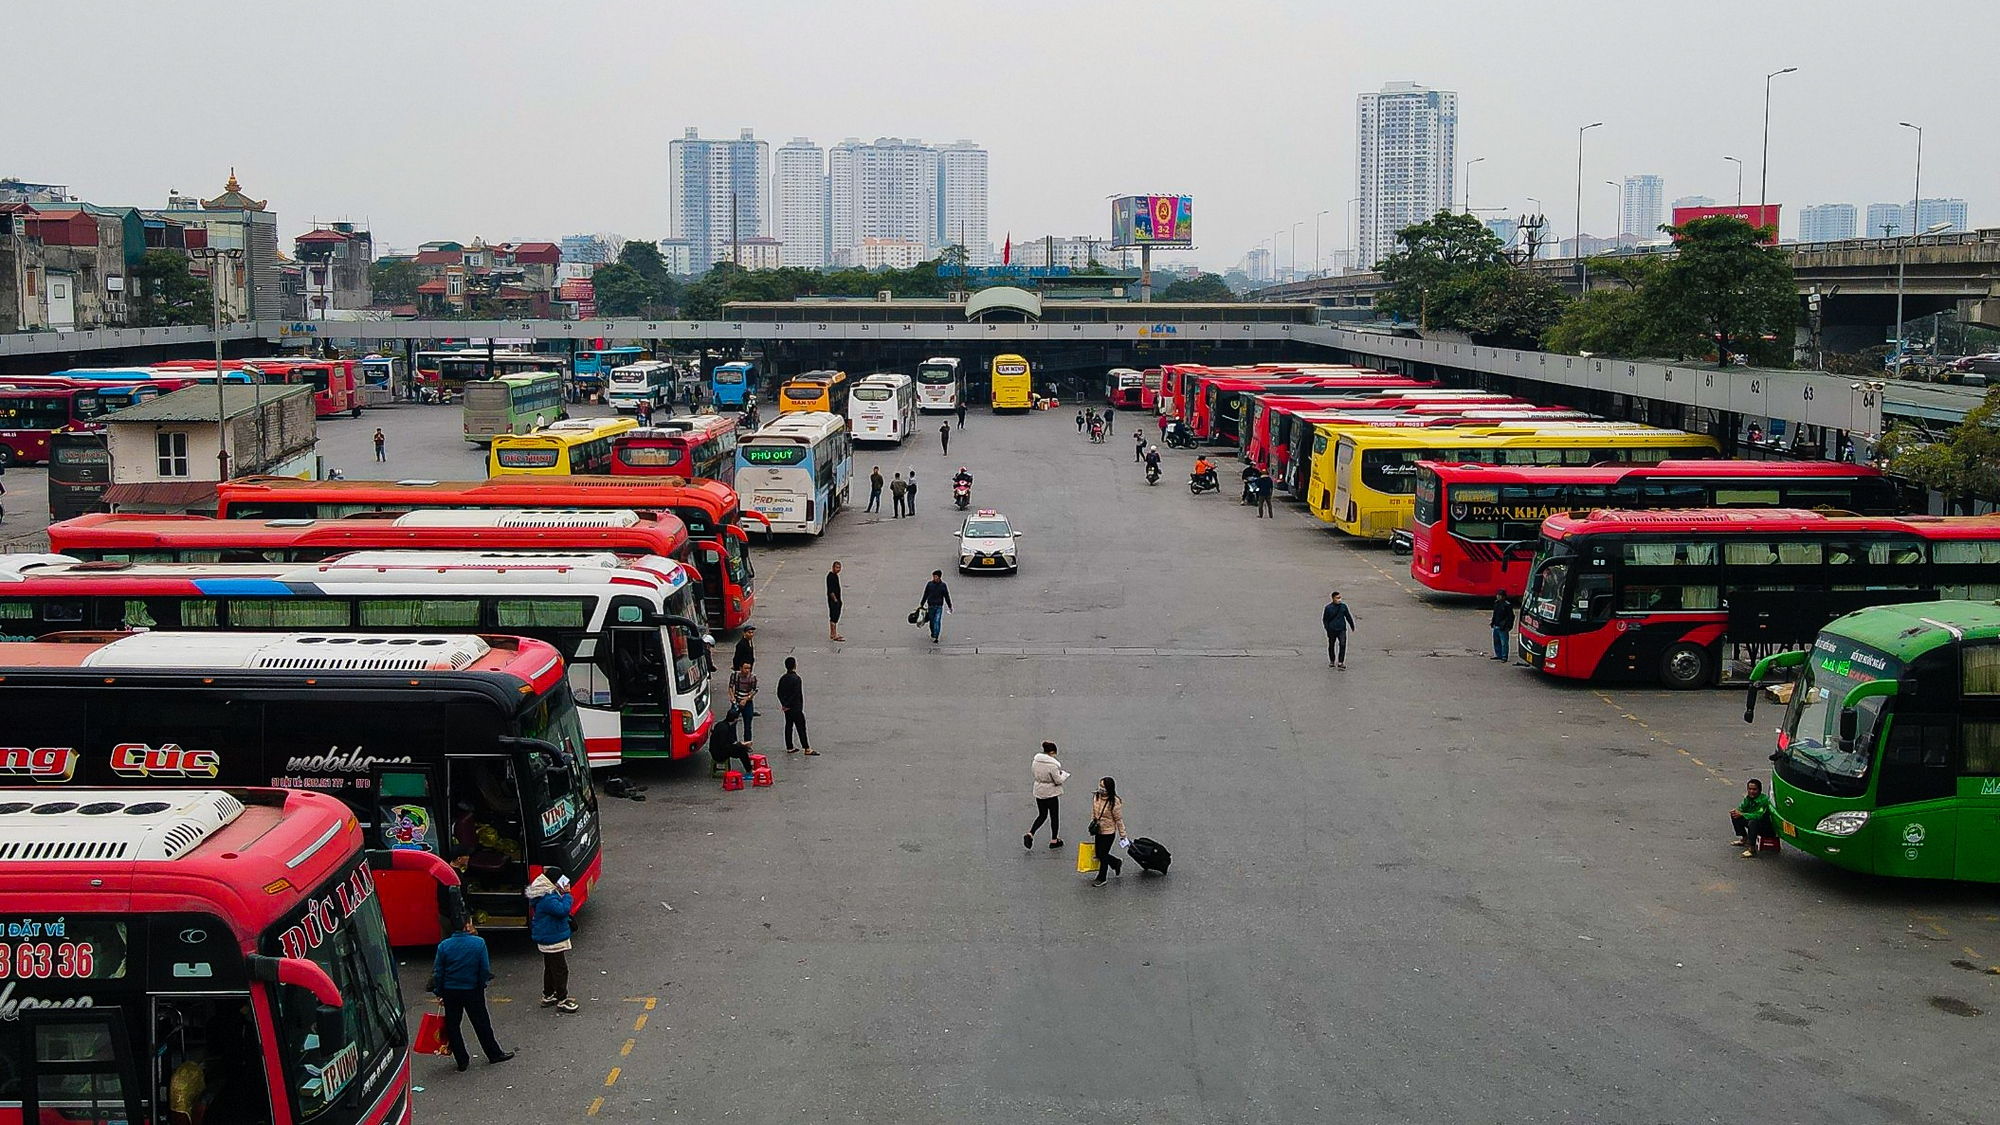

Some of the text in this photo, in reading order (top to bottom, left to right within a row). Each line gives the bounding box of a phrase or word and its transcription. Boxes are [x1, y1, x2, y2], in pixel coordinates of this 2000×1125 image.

[1664, 369, 1673, 382] 60
[1705, 374, 1714, 388] 61
[1750, 379, 1760, 394] 62
[1803, 386, 1814, 401] 63
[1862, 392, 1875, 409] 64
[1472, 506, 1514, 520] DCAR
[110, 743, 220, 779] Cúc
[542, 801, 566, 827] VINH
[8, 918, 42, 942] ĐẶT
[44, 916, 66, 938] VÉ
[16, 942, 53, 979] 63
[57, 942, 94, 979] 36
